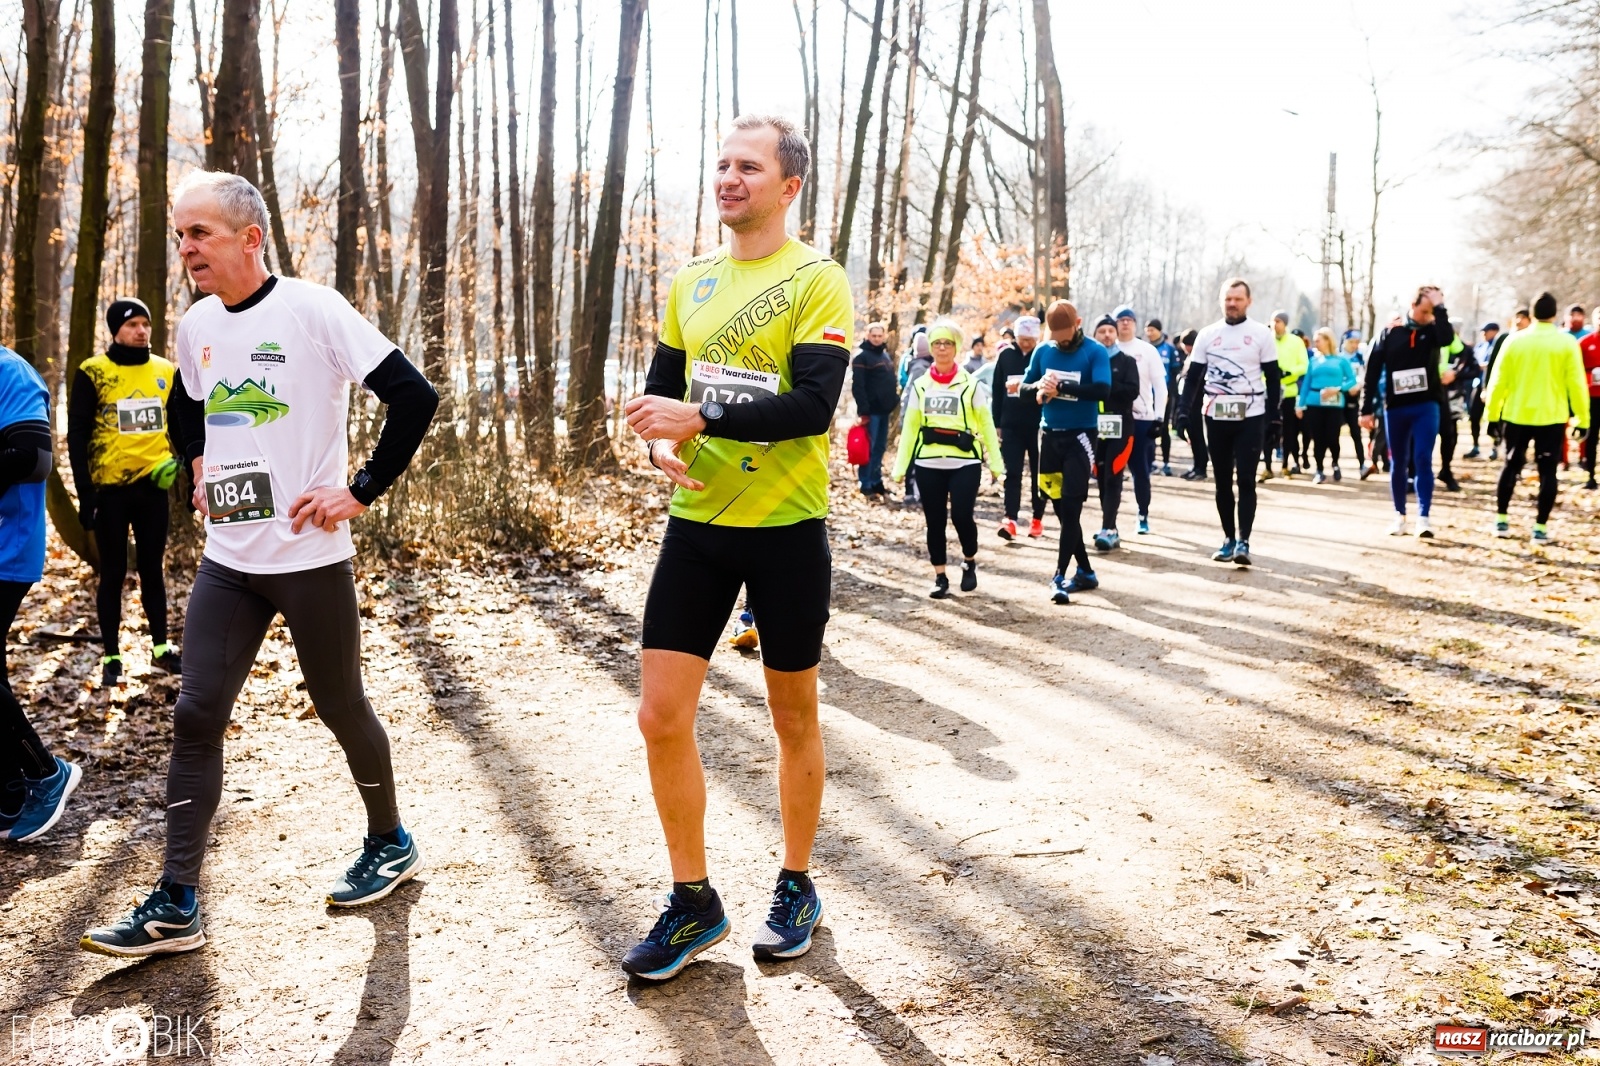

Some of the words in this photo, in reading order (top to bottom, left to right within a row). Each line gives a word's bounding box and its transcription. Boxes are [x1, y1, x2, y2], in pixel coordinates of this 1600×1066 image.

[700, 287, 791, 367] OWICE
[705, 365, 720, 374] BIEG
[721, 367, 768, 383] Twardziela
[930, 397, 953, 410] 077
[1222, 402, 1239, 414] 114
[129, 408, 157, 424] 145
[213, 480, 258, 507] 084
